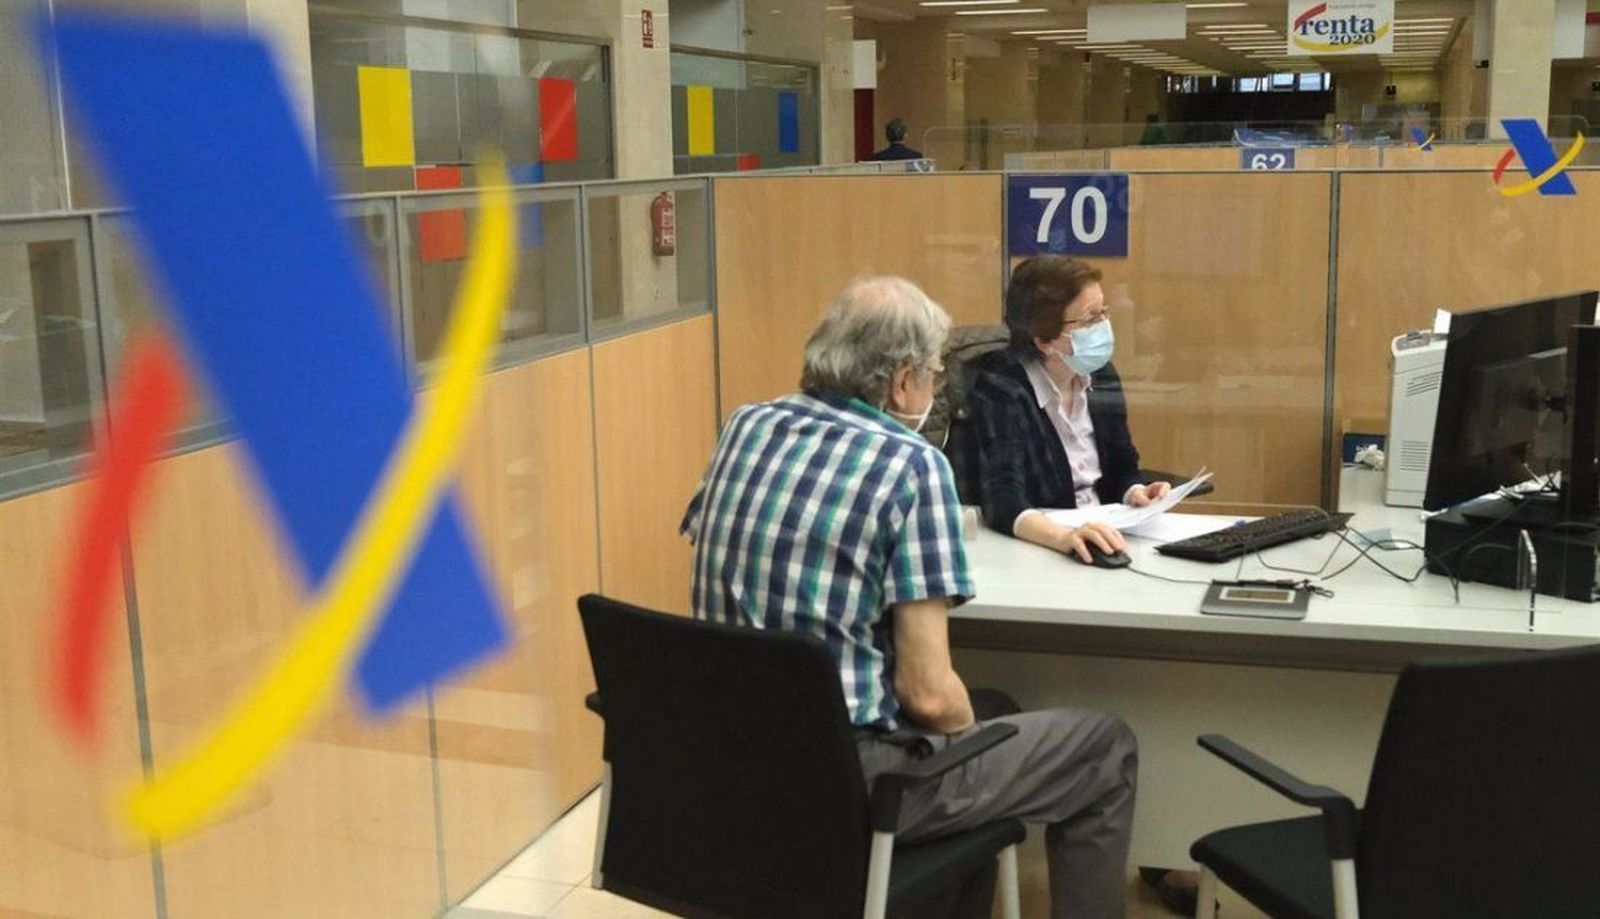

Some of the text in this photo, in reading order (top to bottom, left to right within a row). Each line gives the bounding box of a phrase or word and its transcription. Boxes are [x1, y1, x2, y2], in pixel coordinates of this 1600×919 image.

[1300, 15, 1375, 35] renta
[1329, 33, 1376, 46] 2020
[1252, 153, 1286, 170] 62
[1029, 186, 1108, 244] 70
